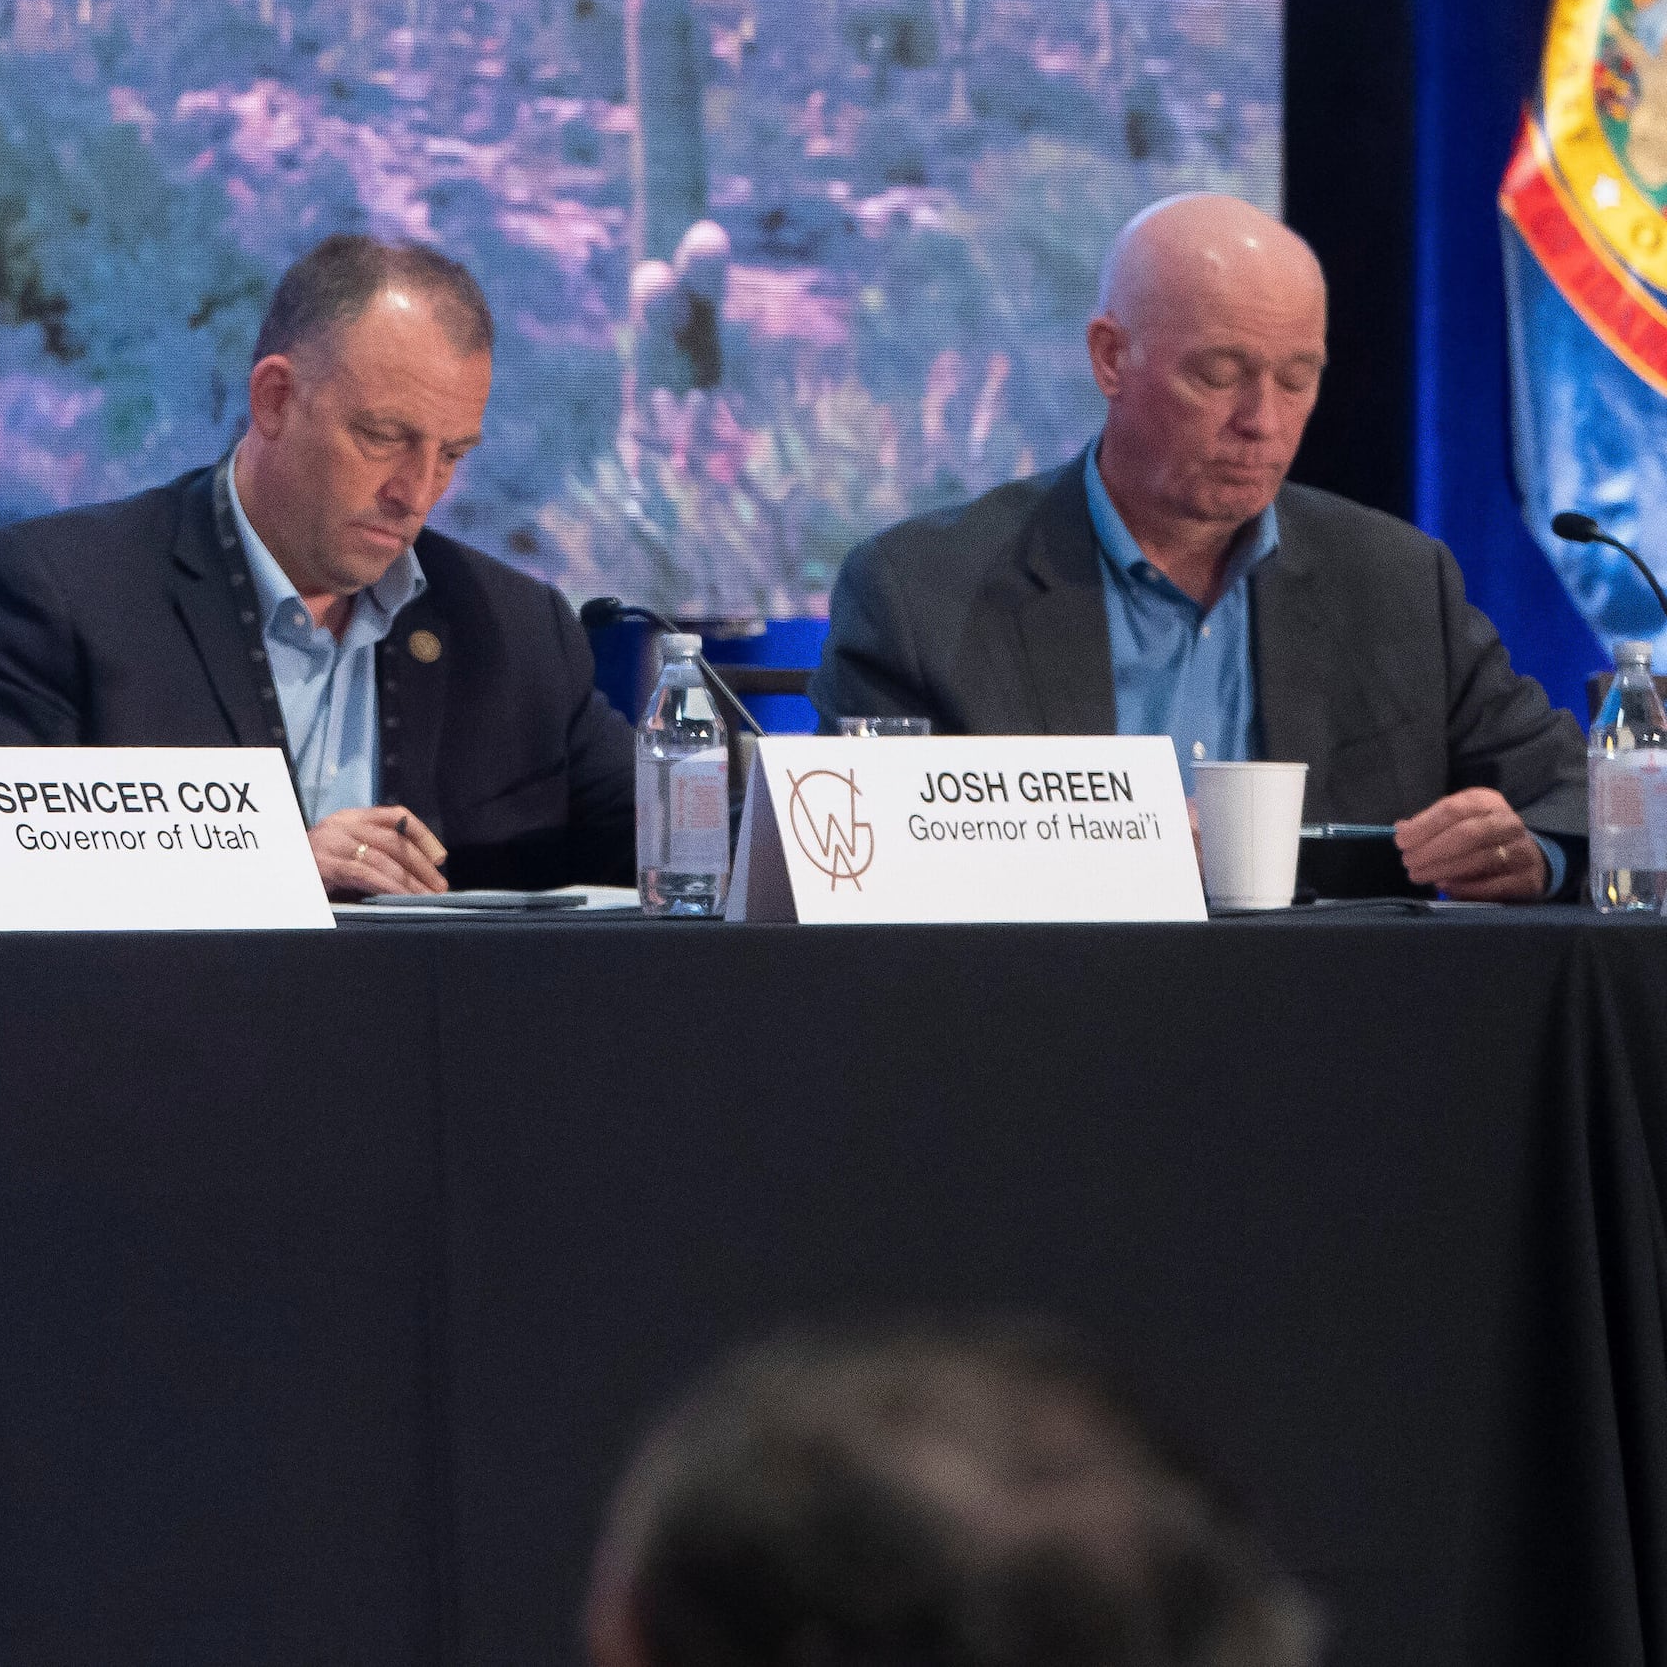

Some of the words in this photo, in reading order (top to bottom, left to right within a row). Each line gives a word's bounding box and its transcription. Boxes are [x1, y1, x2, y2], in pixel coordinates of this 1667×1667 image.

[177, 781, 260, 814] COX
[919, 771, 1010, 804] JOSH
[1018, 770, 1134, 804] GREEN
[15, 823, 146, 851] Governor
[156, 823, 184, 850] of
[191, 823, 259, 850] Utah
[908, 813, 1028, 841] Governor
[1036, 813, 1060, 841] of
[1069, 813, 1162, 841] Hawai'i
